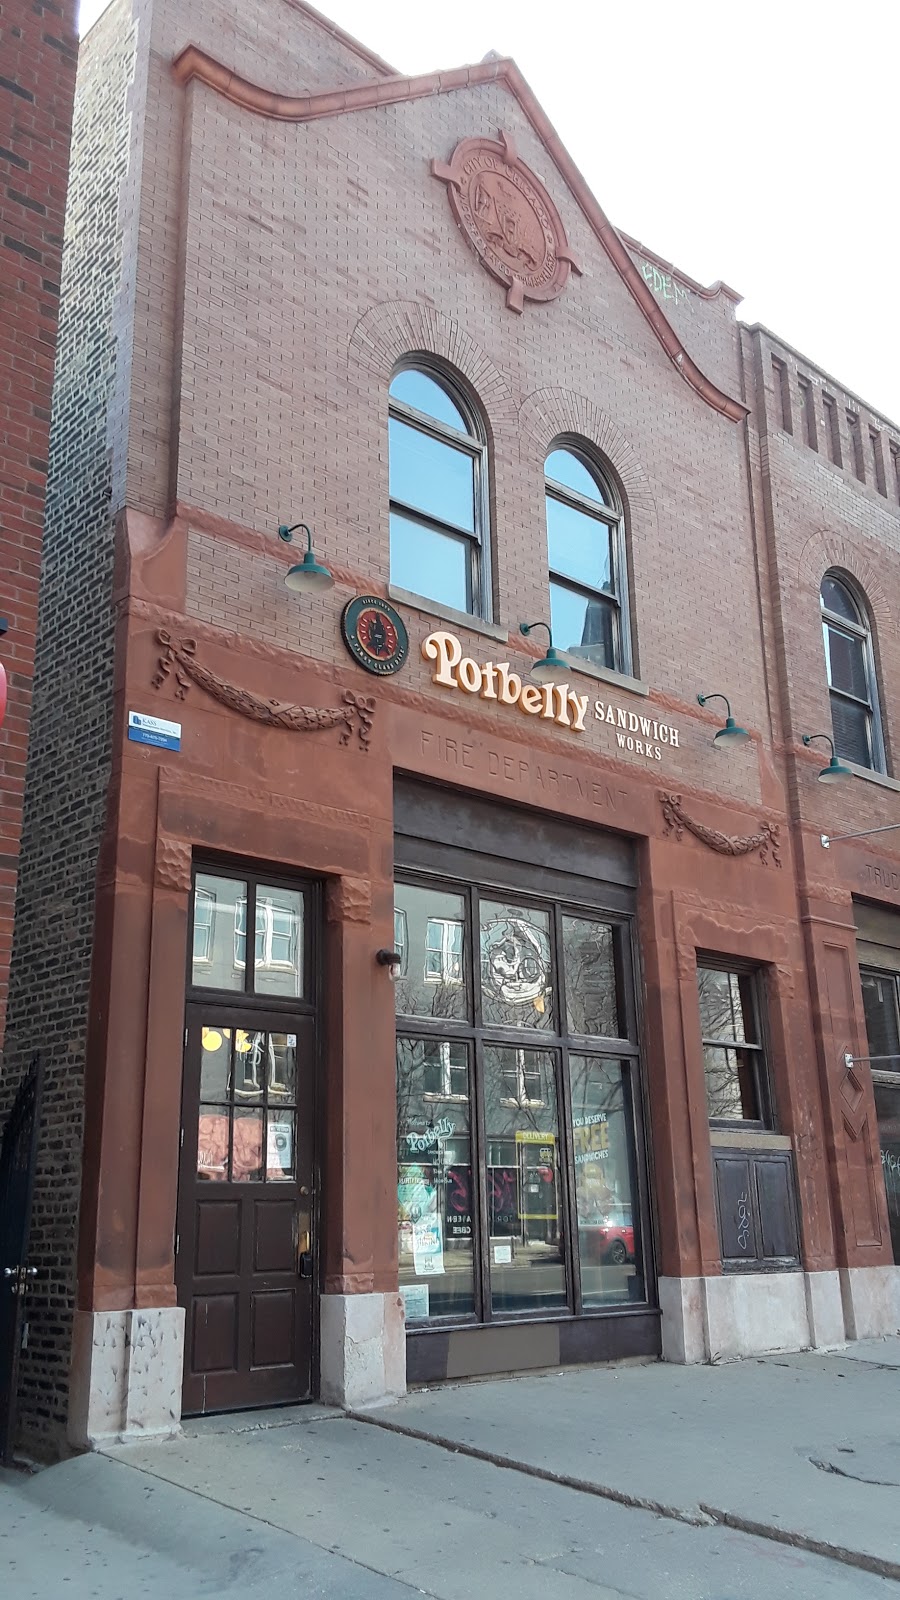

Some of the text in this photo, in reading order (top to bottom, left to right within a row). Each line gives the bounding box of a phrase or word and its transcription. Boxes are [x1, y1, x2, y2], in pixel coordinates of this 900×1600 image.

[463, 155, 482, 176] CITY
[483, 157, 498, 170] OF
[374, 662, 394, 670] CLASS
[421, 631, 589, 732] Potbelly
[142, 717, 157, 726] KASS
[594, 700, 680, 748] SANDWICH
[615, 732, 662, 761] WORKS
[420, 730, 629, 813] FIRE DEPARTMENT
[573, 1113, 607, 1128] YOU DESERVE
[406, 1116, 456, 1153] Potbelly
[522, 1131, 549, 1141] DELIVERY
[573, 1121, 609, 1154] FREE
[574, 1149, 609, 1165] SANDWICHES
